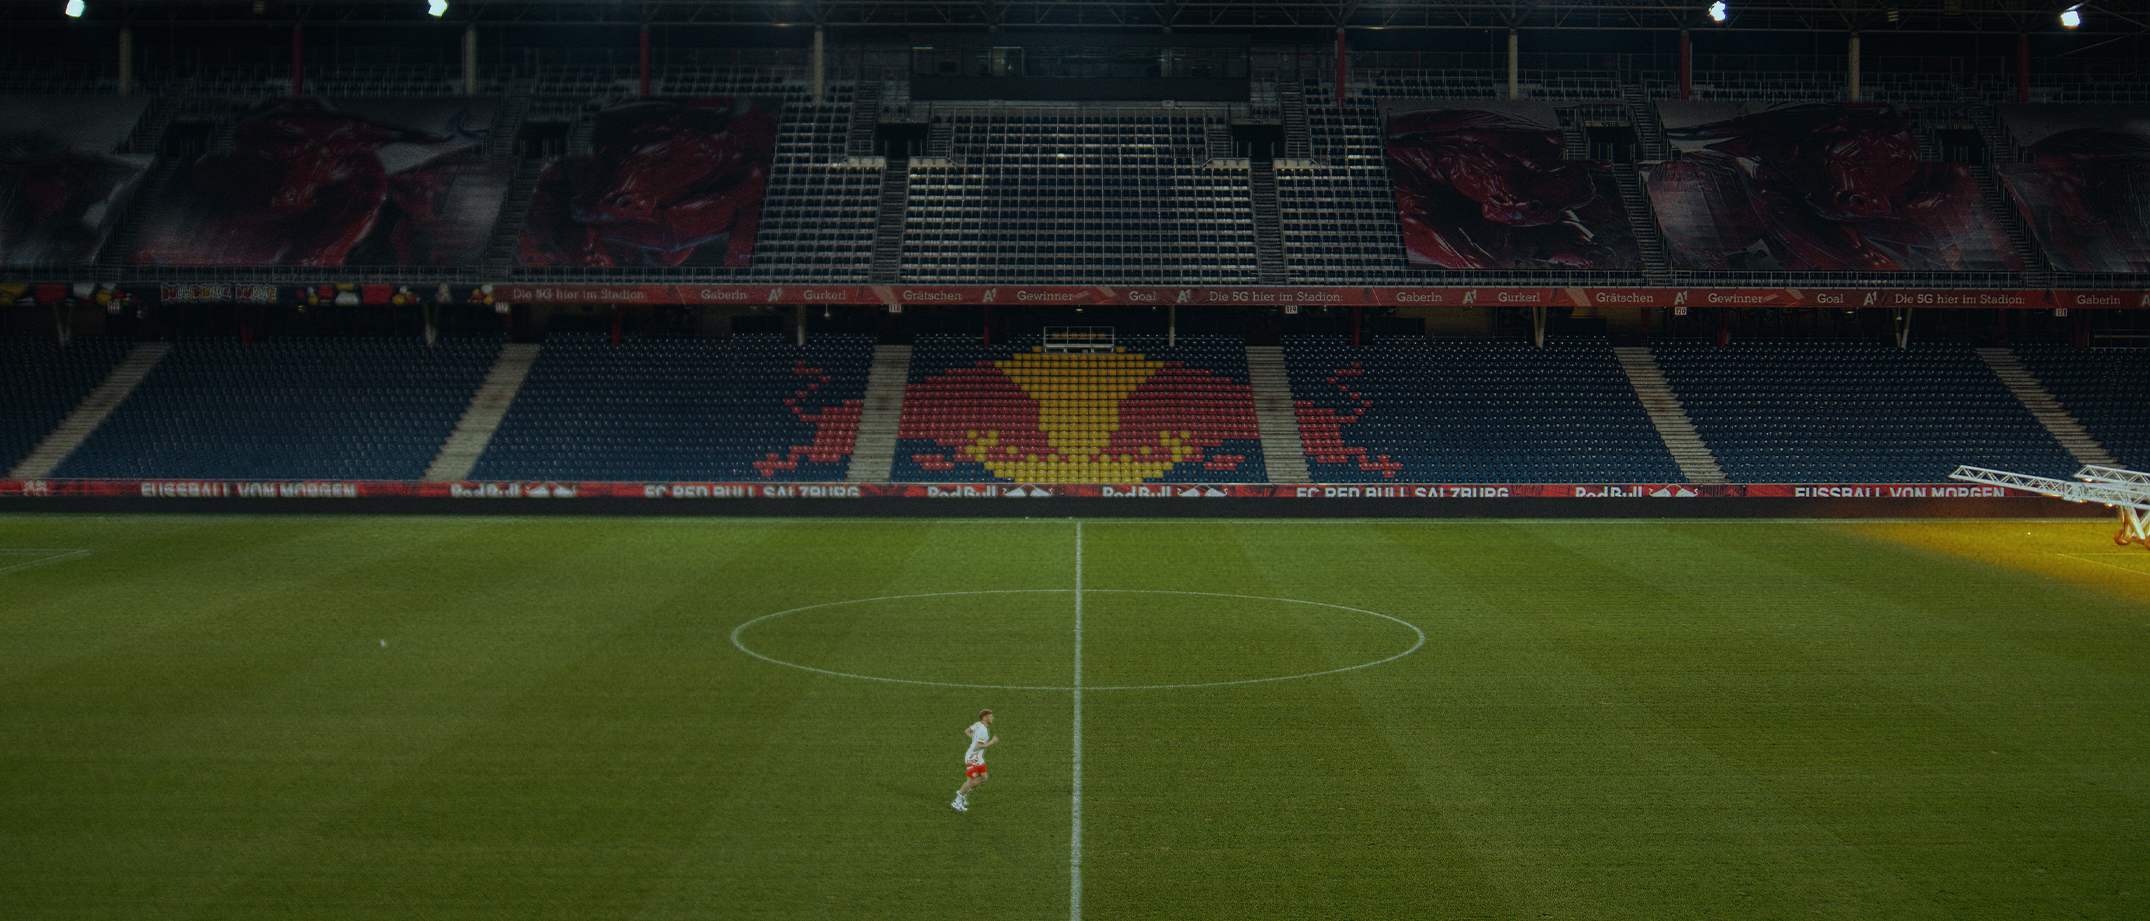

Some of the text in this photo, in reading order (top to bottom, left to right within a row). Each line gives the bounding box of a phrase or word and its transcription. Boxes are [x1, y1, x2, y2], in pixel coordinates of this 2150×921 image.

[513, 288, 532, 299] Die
[556, 288, 579, 299] hier
[583, 288, 597, 299] im
[803, 290, 846, 300] Gurkerl
[903, 290, 962, 301] Grätschen
[1017, 290, 1074, 301] Gewinner
[1129, 291, 1156, 301] Goal
[1210, 291, 1228, 301] Die
[1252, 291, 1275, 301] hier
[1279, 291, 1293, 301] im
[1296, 291, 1343, 301] Stadion:
[1396, 292, 1443, 302] Gaberln
[1498, 292, 1540, 302] Gurkerl
[1596, 292, 1654, 302] Grätschen
[1708, 293, 1762, 303] Gewinner
[1817, 294, 1844, 304] Goal
[1895, 294, 1914, 304] Die
[1937, 294, 1959, 304] hier
[1962, 294, 1976, 304] im
[1980, 294, 2025, 304] Stadion:
[2076, 295, 2121, 305] Gaberln
[644, 485, 860, 497] FC RED BULL SALZBURG
[1296, 487, 1509, 497] FC RED BULL SALZBURG
[1795, 487, 2005, 497] FUSSBALL VON MORGEN
